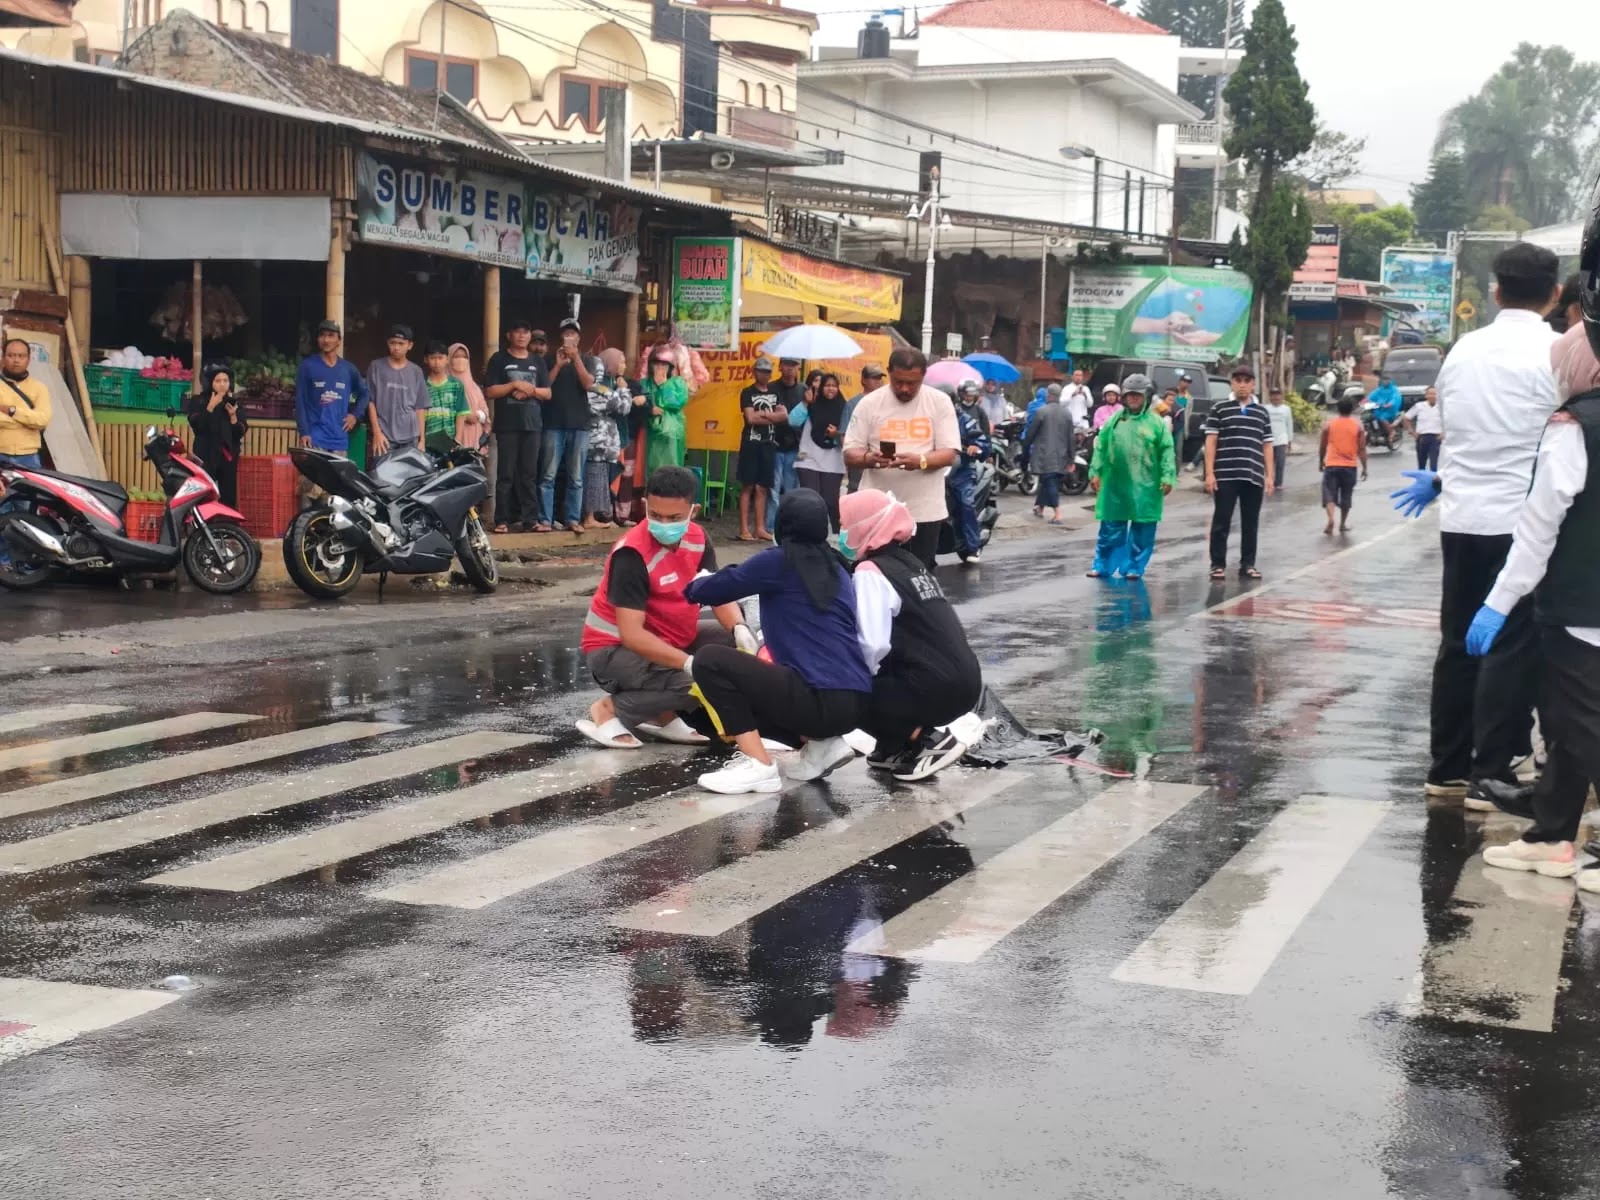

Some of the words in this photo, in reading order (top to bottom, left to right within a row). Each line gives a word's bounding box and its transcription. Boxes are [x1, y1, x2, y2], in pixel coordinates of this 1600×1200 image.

[375, 168, 522, 227] SUMBER
[534, 200, 609, 242] BUAH
[366, 223, 398, 238] MENJUAL
[399, 228, 426, 240] SEGALA
[427, 231, 451, 244] MACAM
[588, 243, 605, 265] PAK
[680, 259, 728, 280] BUAH
[1072, 287, 1125, 298] PROGRAM
